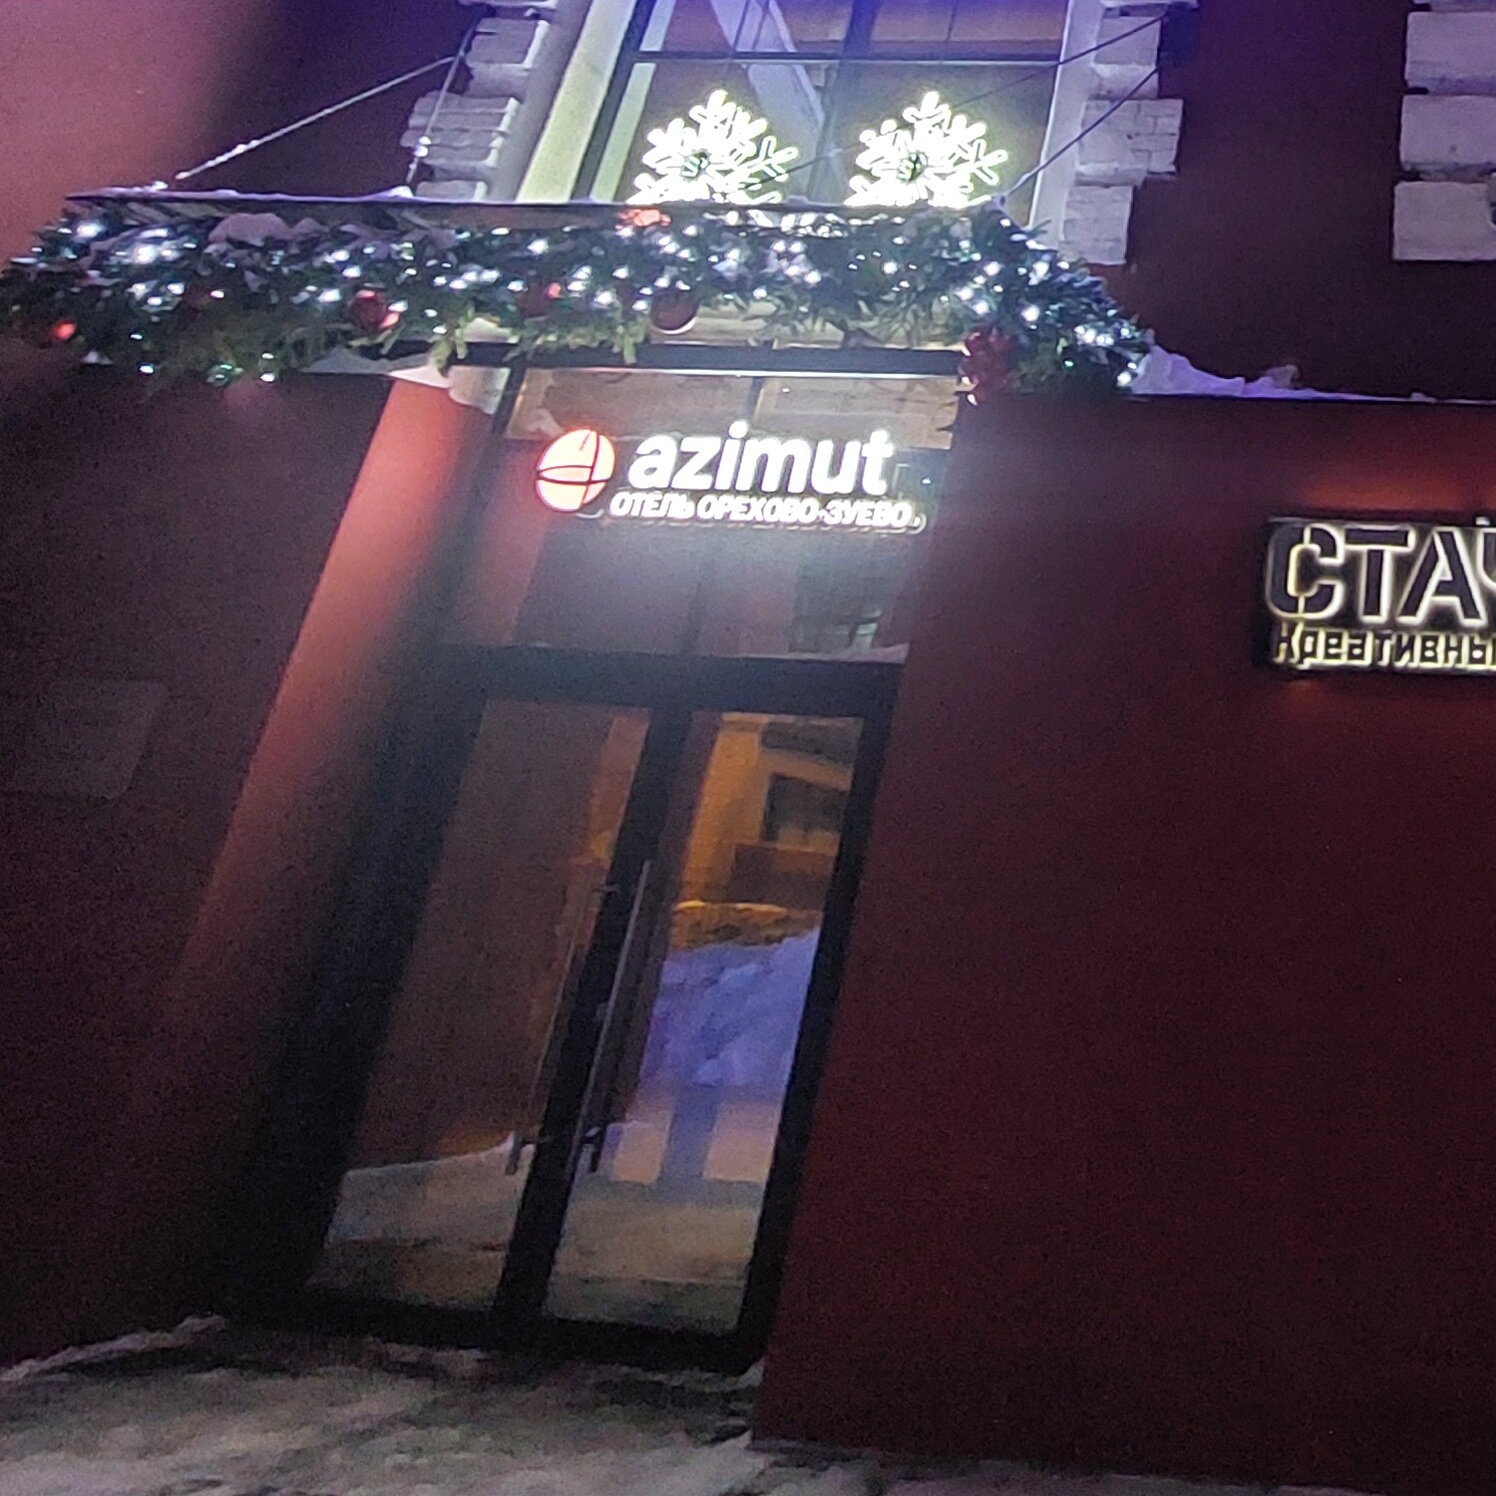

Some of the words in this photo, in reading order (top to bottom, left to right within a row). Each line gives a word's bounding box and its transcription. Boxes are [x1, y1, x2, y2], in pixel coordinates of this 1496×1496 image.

[627, 420, 894, 495] azimut
[609, 491, 694, 519] ОТЕЛЬ
[697, 495, 912, 528] ОРЕХОВО-ЗУЕВО
